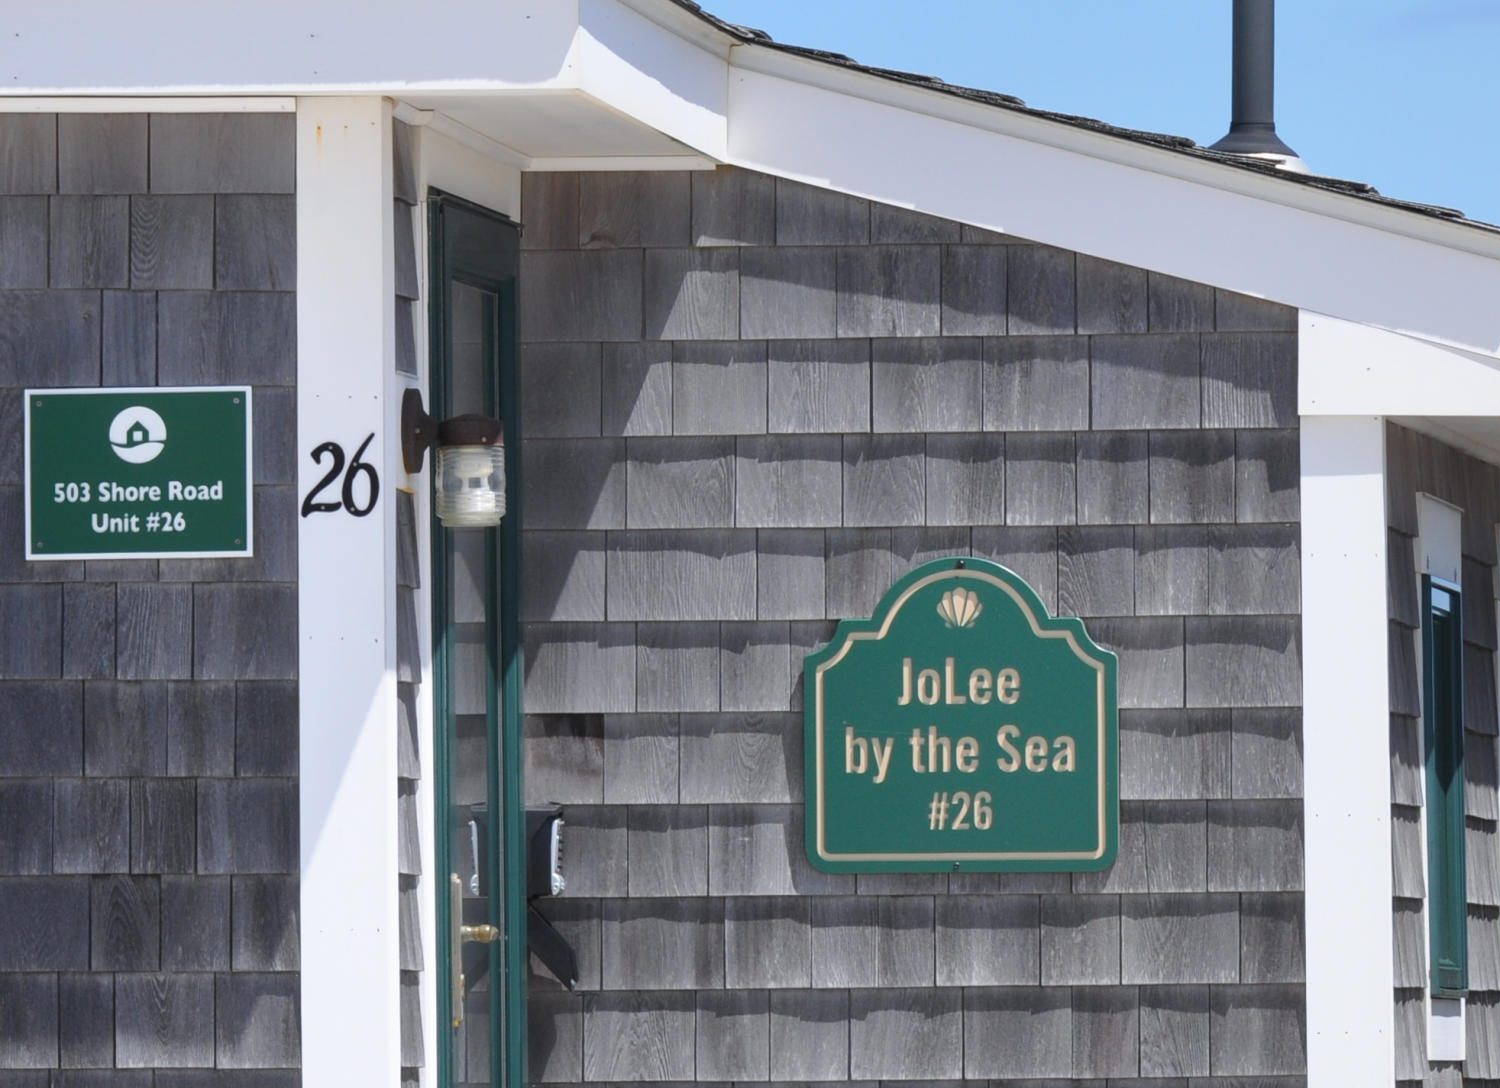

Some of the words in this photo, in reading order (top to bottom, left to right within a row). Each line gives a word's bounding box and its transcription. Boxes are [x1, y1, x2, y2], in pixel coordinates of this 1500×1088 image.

[54, 482, 91, 503] 503
[98, 481, 161, 502] Shore
[168, 480, 223, 501] Road
[301, 432, 380, 518] 26
[91, 512, 139, 534] Unit
[146, 511, 186, 533] #26
[897, 657, 1021, 705] JoLee
[845, 726, 894, 784] by
[909, 726, 979, 774] the
[996, 724, 1076, 773] Sea
[928, 791, 993, 831] #26
